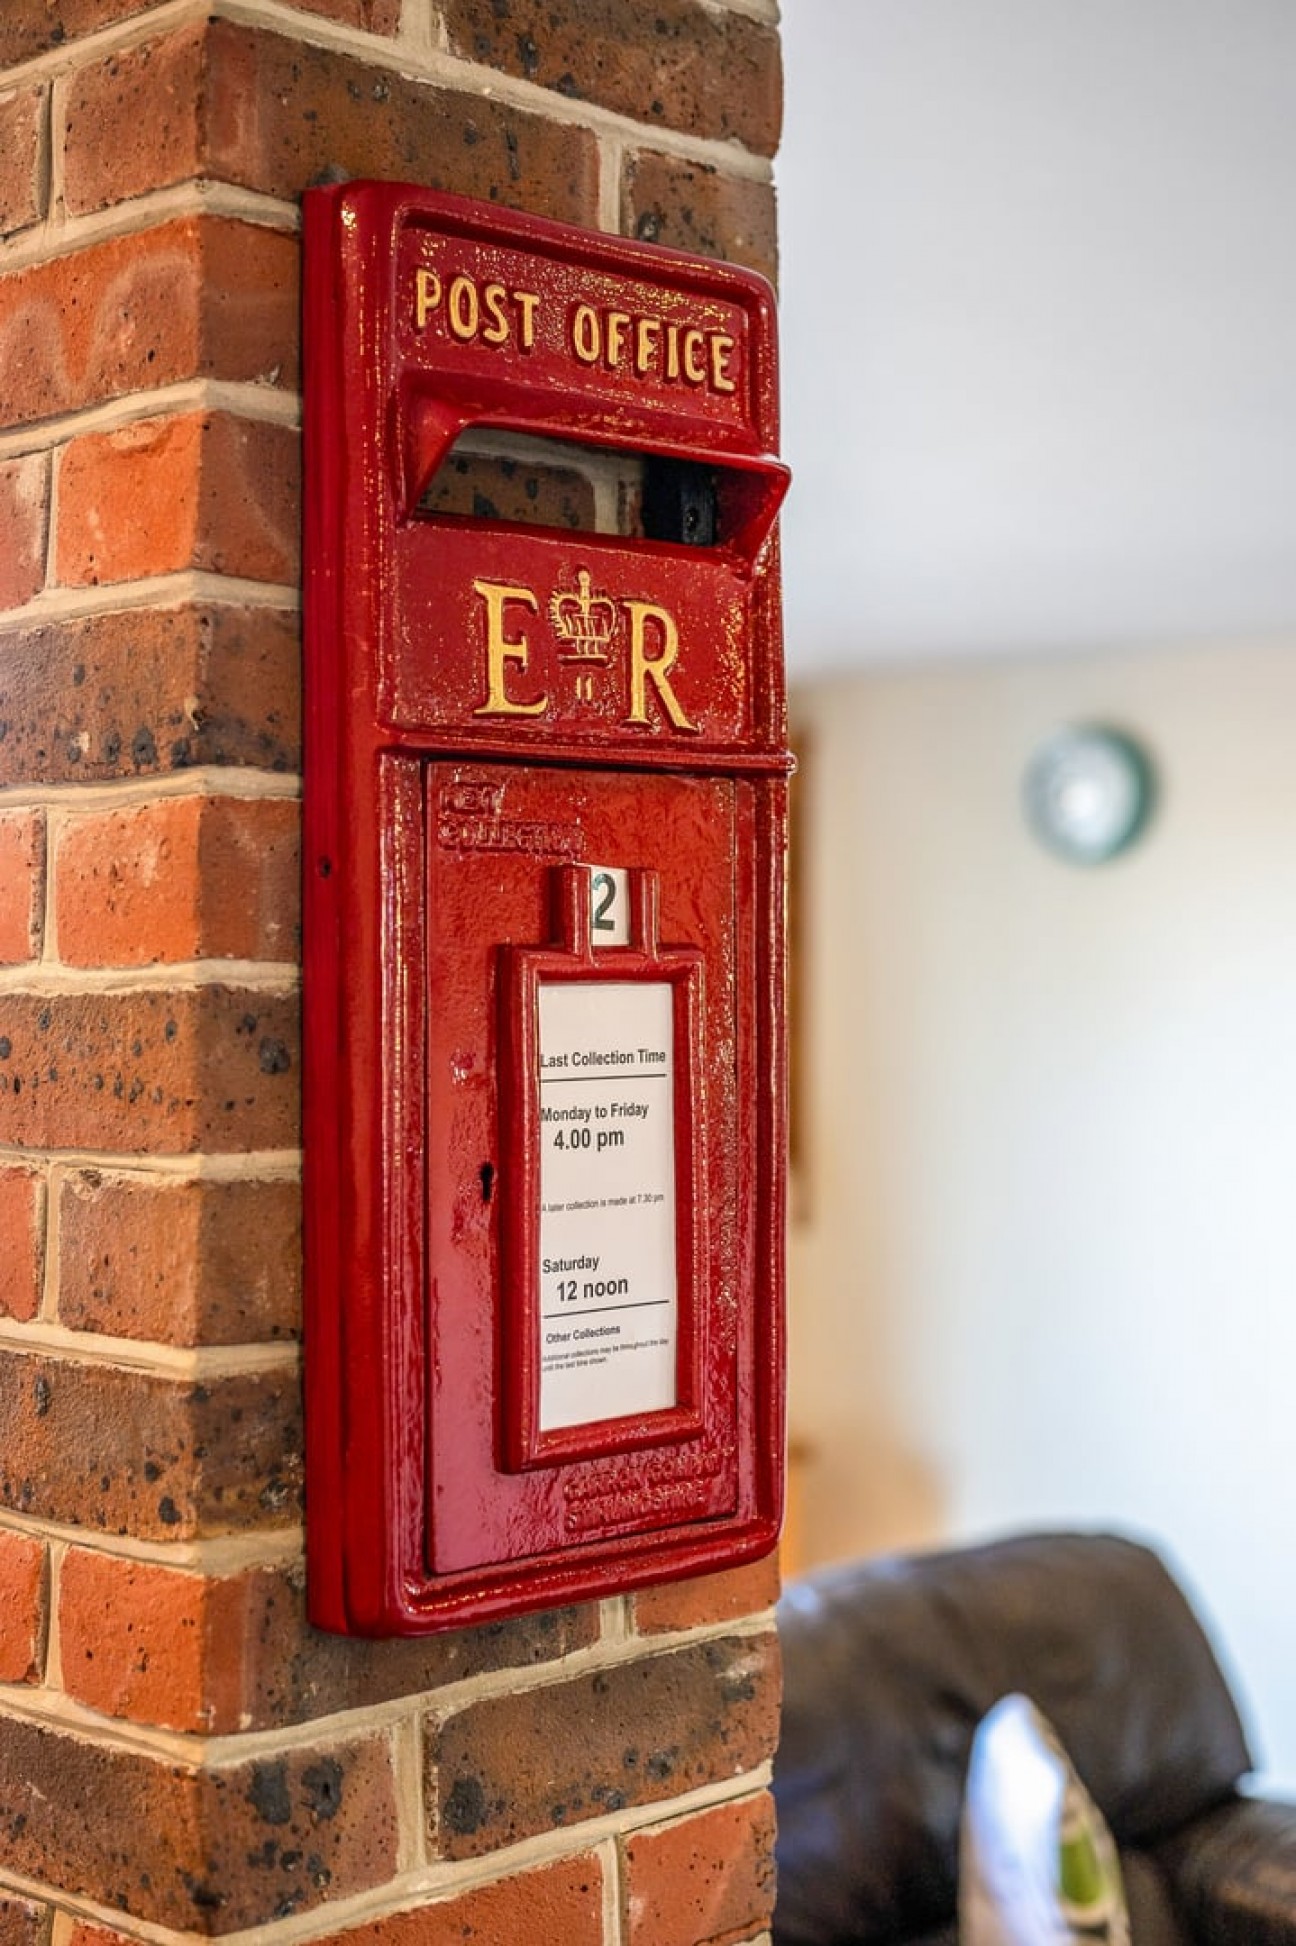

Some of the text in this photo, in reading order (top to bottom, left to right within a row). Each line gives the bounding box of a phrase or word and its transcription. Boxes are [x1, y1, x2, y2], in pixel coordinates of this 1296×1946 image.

[415, 268, 735, 391] POST OFFICE
[473, 579, 699, 730] E R
[592, 873, 616, 930] 2
[540, 1048, 666, 1067] Last Collection Time
[541, 1102, 649, 1123] Monday to Friday
[554, 1128, 624, 1151] 4.00 pm
[566, 1201, 598, 1211] collection
[607, 1197, 627, 1206] made
[542, 1255, 599, 1274] Saturday
[556, 1279, 628, 1302] 12 noon
[546, 1326, 620, 1344] Other Collections
